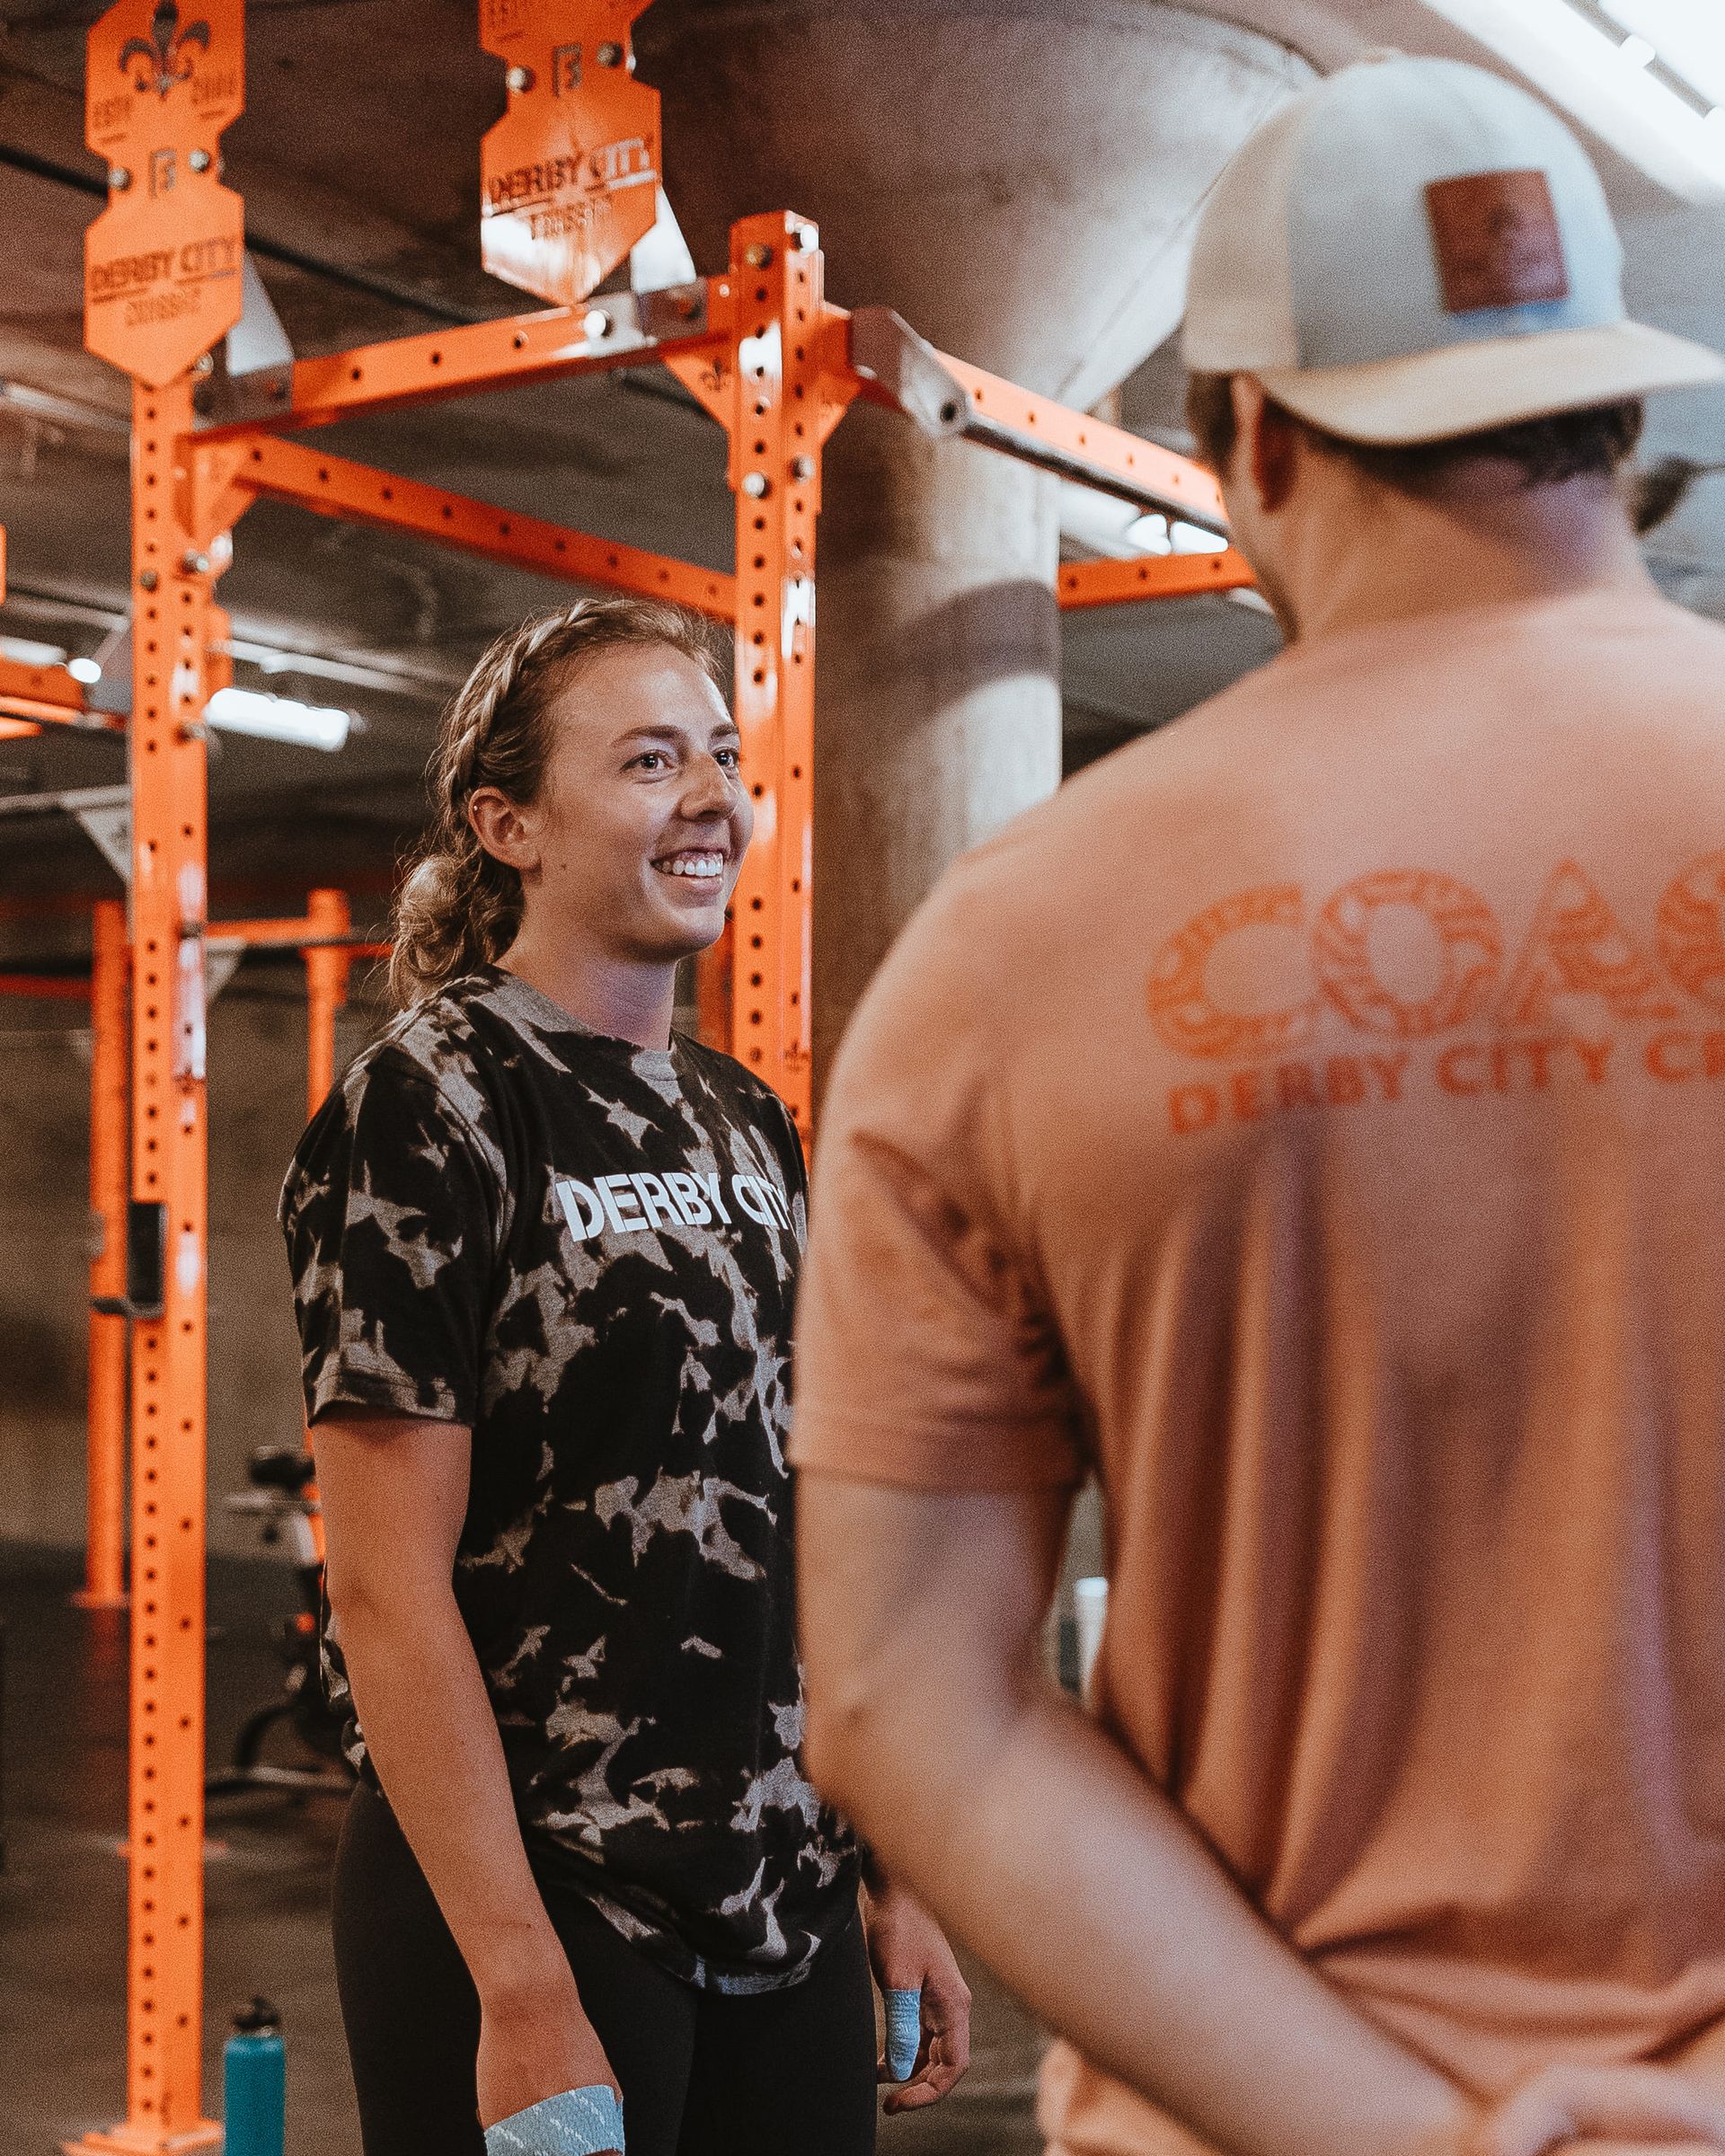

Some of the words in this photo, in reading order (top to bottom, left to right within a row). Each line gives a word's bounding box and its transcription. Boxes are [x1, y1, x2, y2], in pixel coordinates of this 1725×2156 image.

[1168, 1051, 1409, 1135] DERBY
[1438, 1036, 1614, 1095] CITY
[555, 1172, 732, 1242] DERBY
